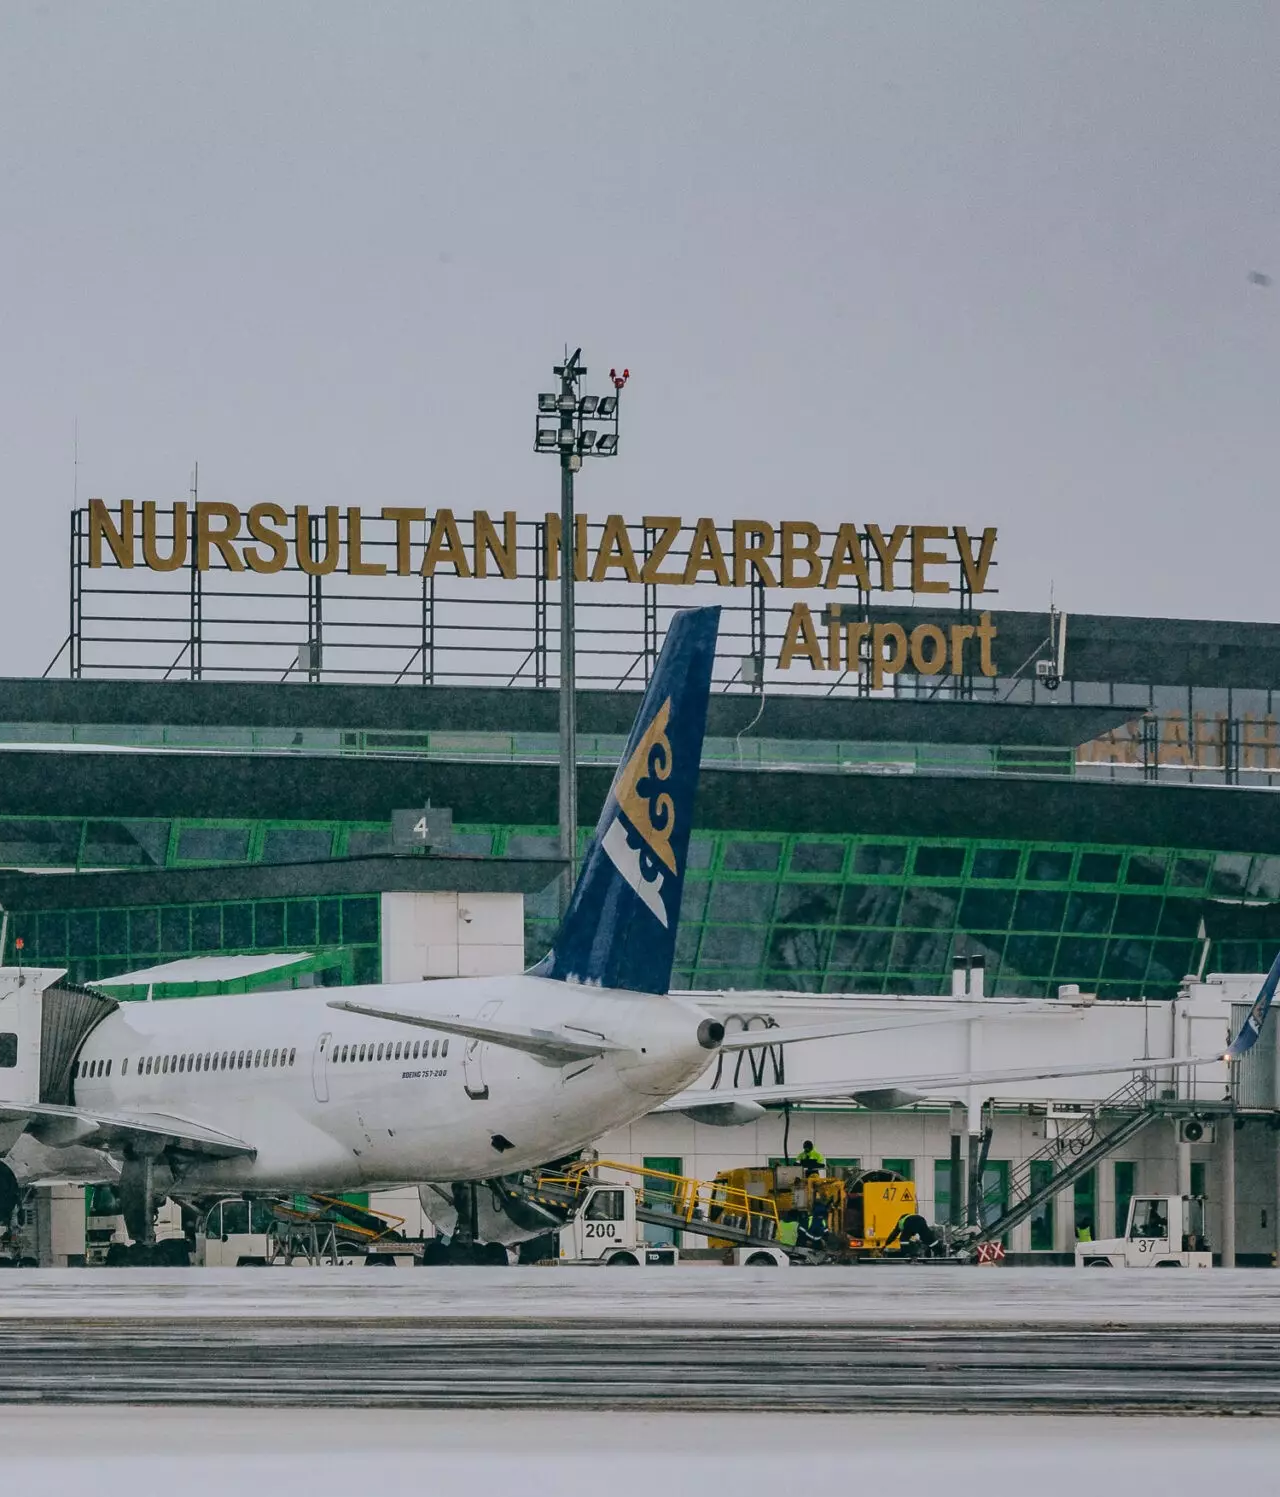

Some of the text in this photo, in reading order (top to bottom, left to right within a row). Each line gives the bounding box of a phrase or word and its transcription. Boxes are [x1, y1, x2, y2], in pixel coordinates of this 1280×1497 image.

[88, 499, 997, 593] NURSULTAN NAZARBAYEV
[776, 602, 997, 690] Airport
[413, 816, 429, 839] 4
[402, 1069, 448, 1079] BOEING 757-200
[883, 1187, 897, 1201] 47
[585, 1223, 616, 1238] 200
[1138, 1239, 1156, 1253] 37
